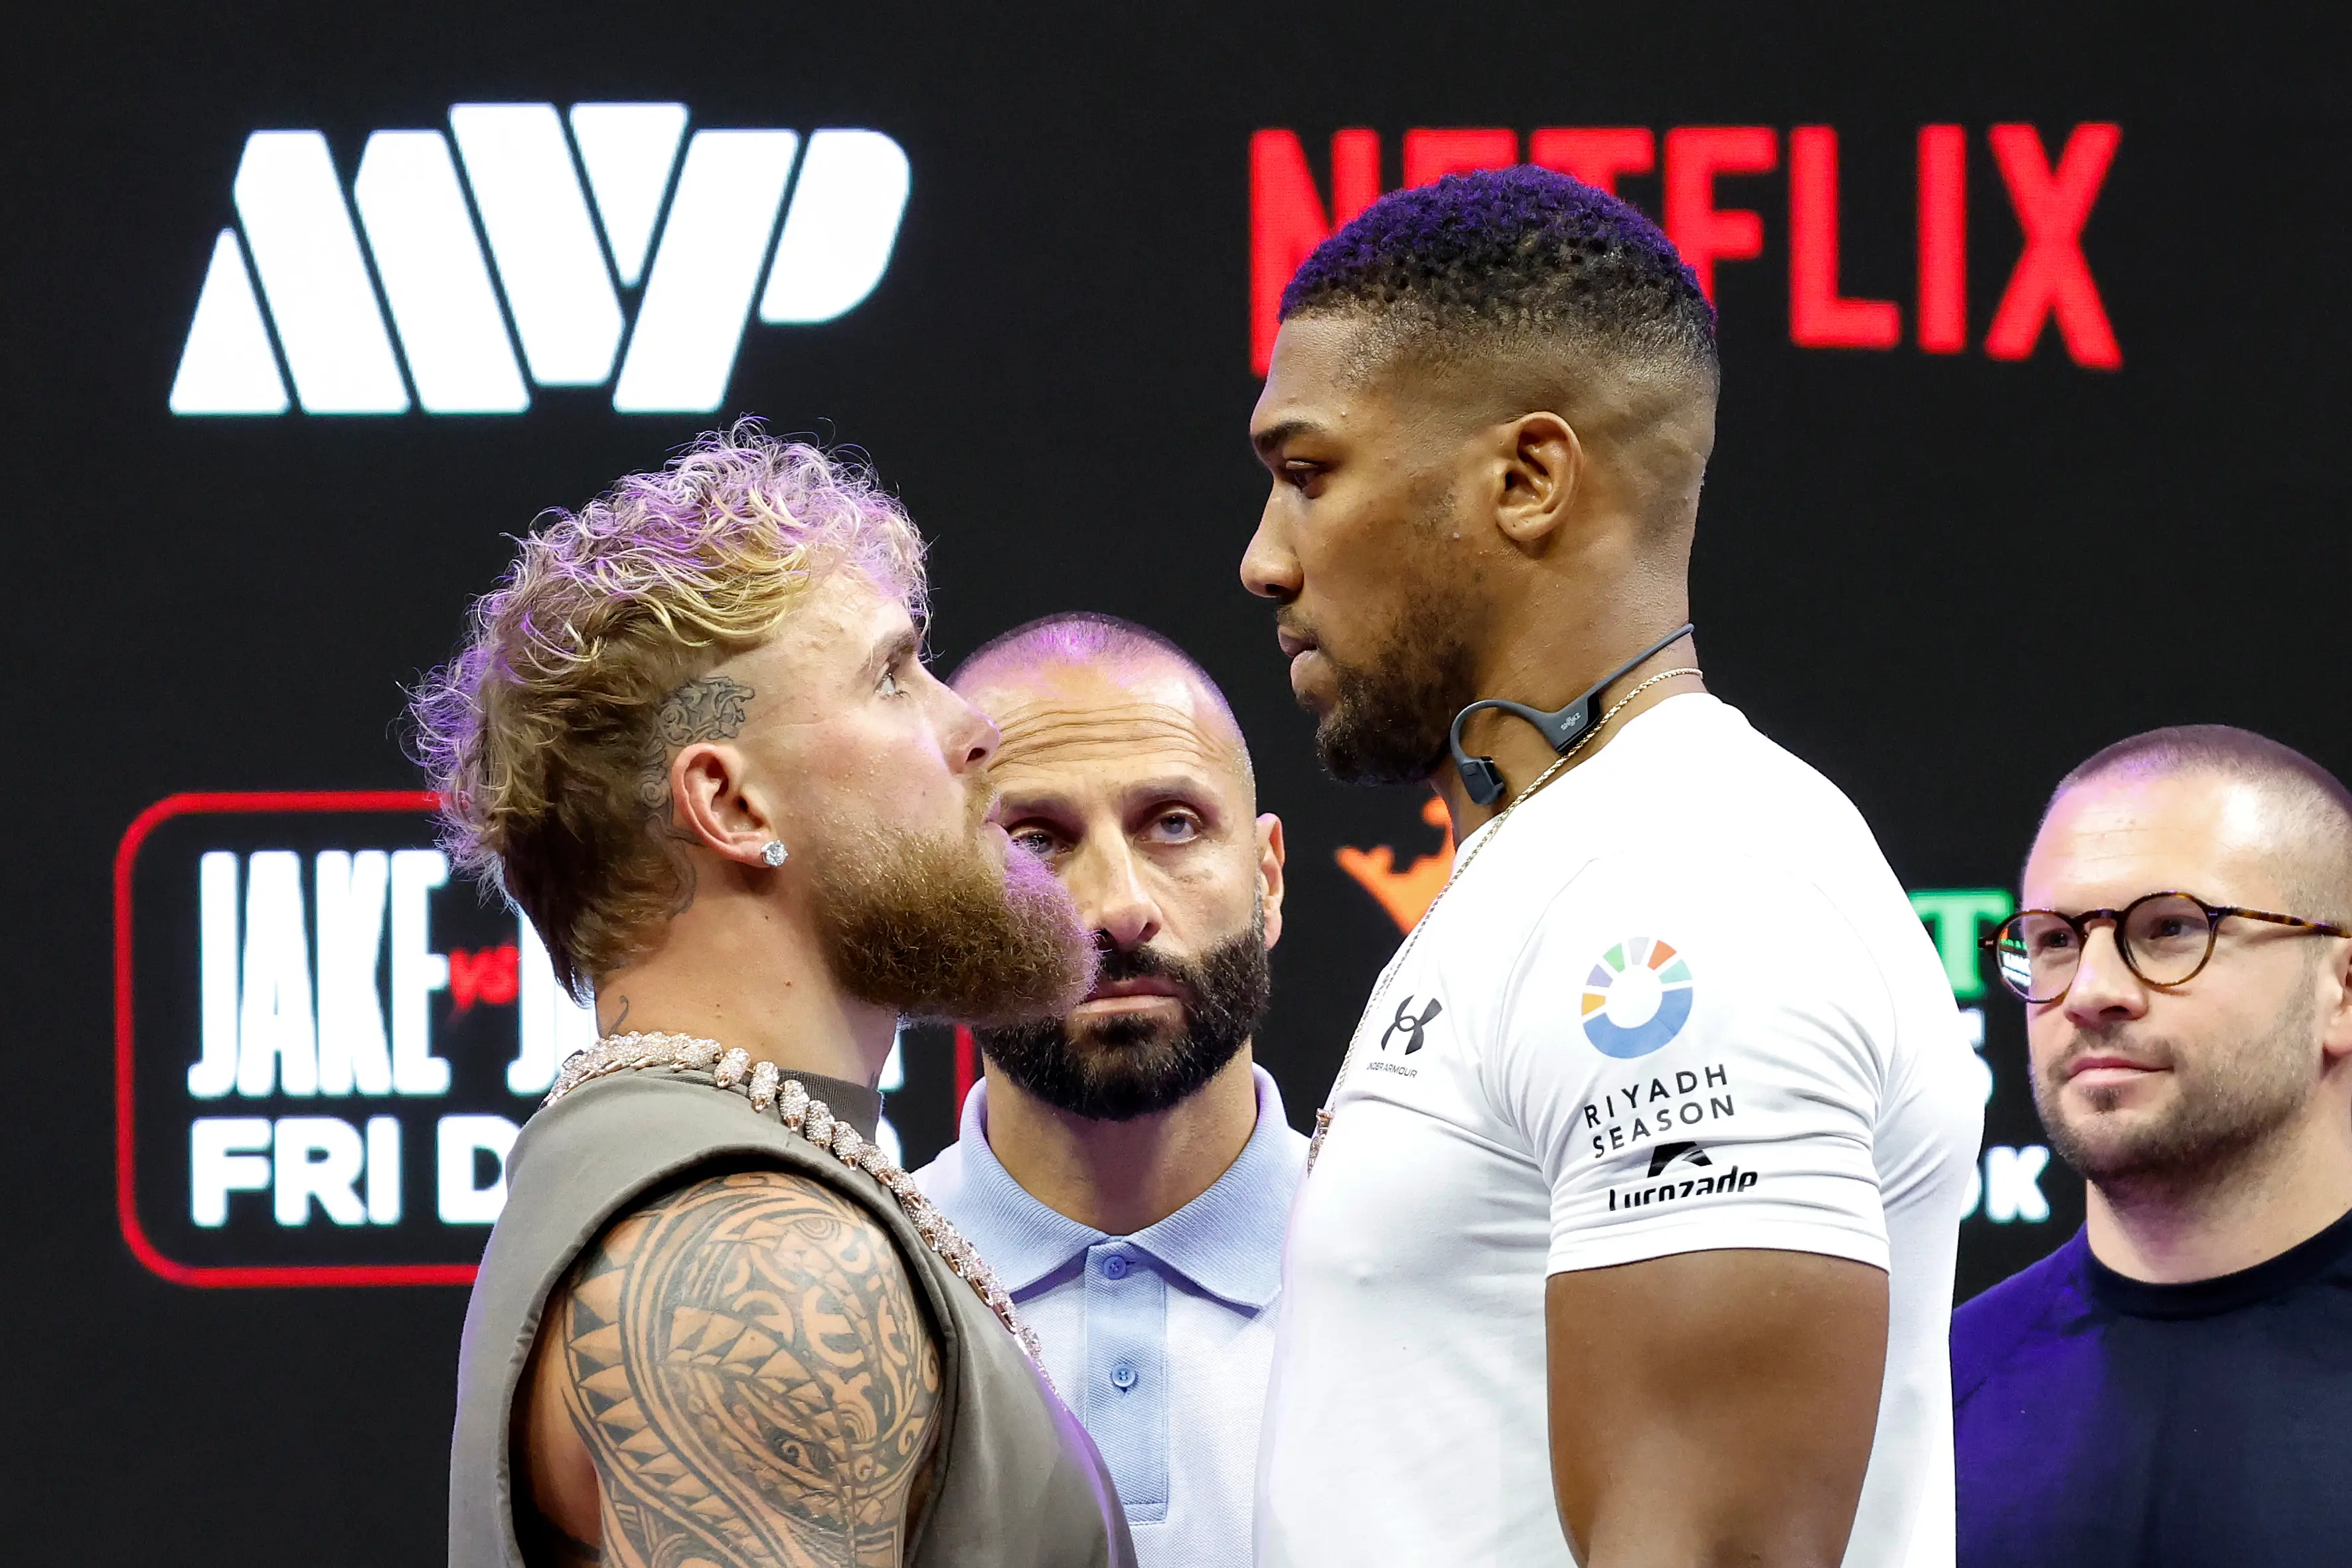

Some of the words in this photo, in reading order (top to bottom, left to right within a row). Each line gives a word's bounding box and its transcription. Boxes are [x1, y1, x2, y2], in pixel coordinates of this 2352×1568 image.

[169, 102, 911, 416] MVP
[187, 850, 451, 1098] JAKE
[1584, 1063, 1727, 1129] RIYADH
[1593, 1094, 1735, 1159] SEASON
[190, 1115, 403, 1227] FRI
